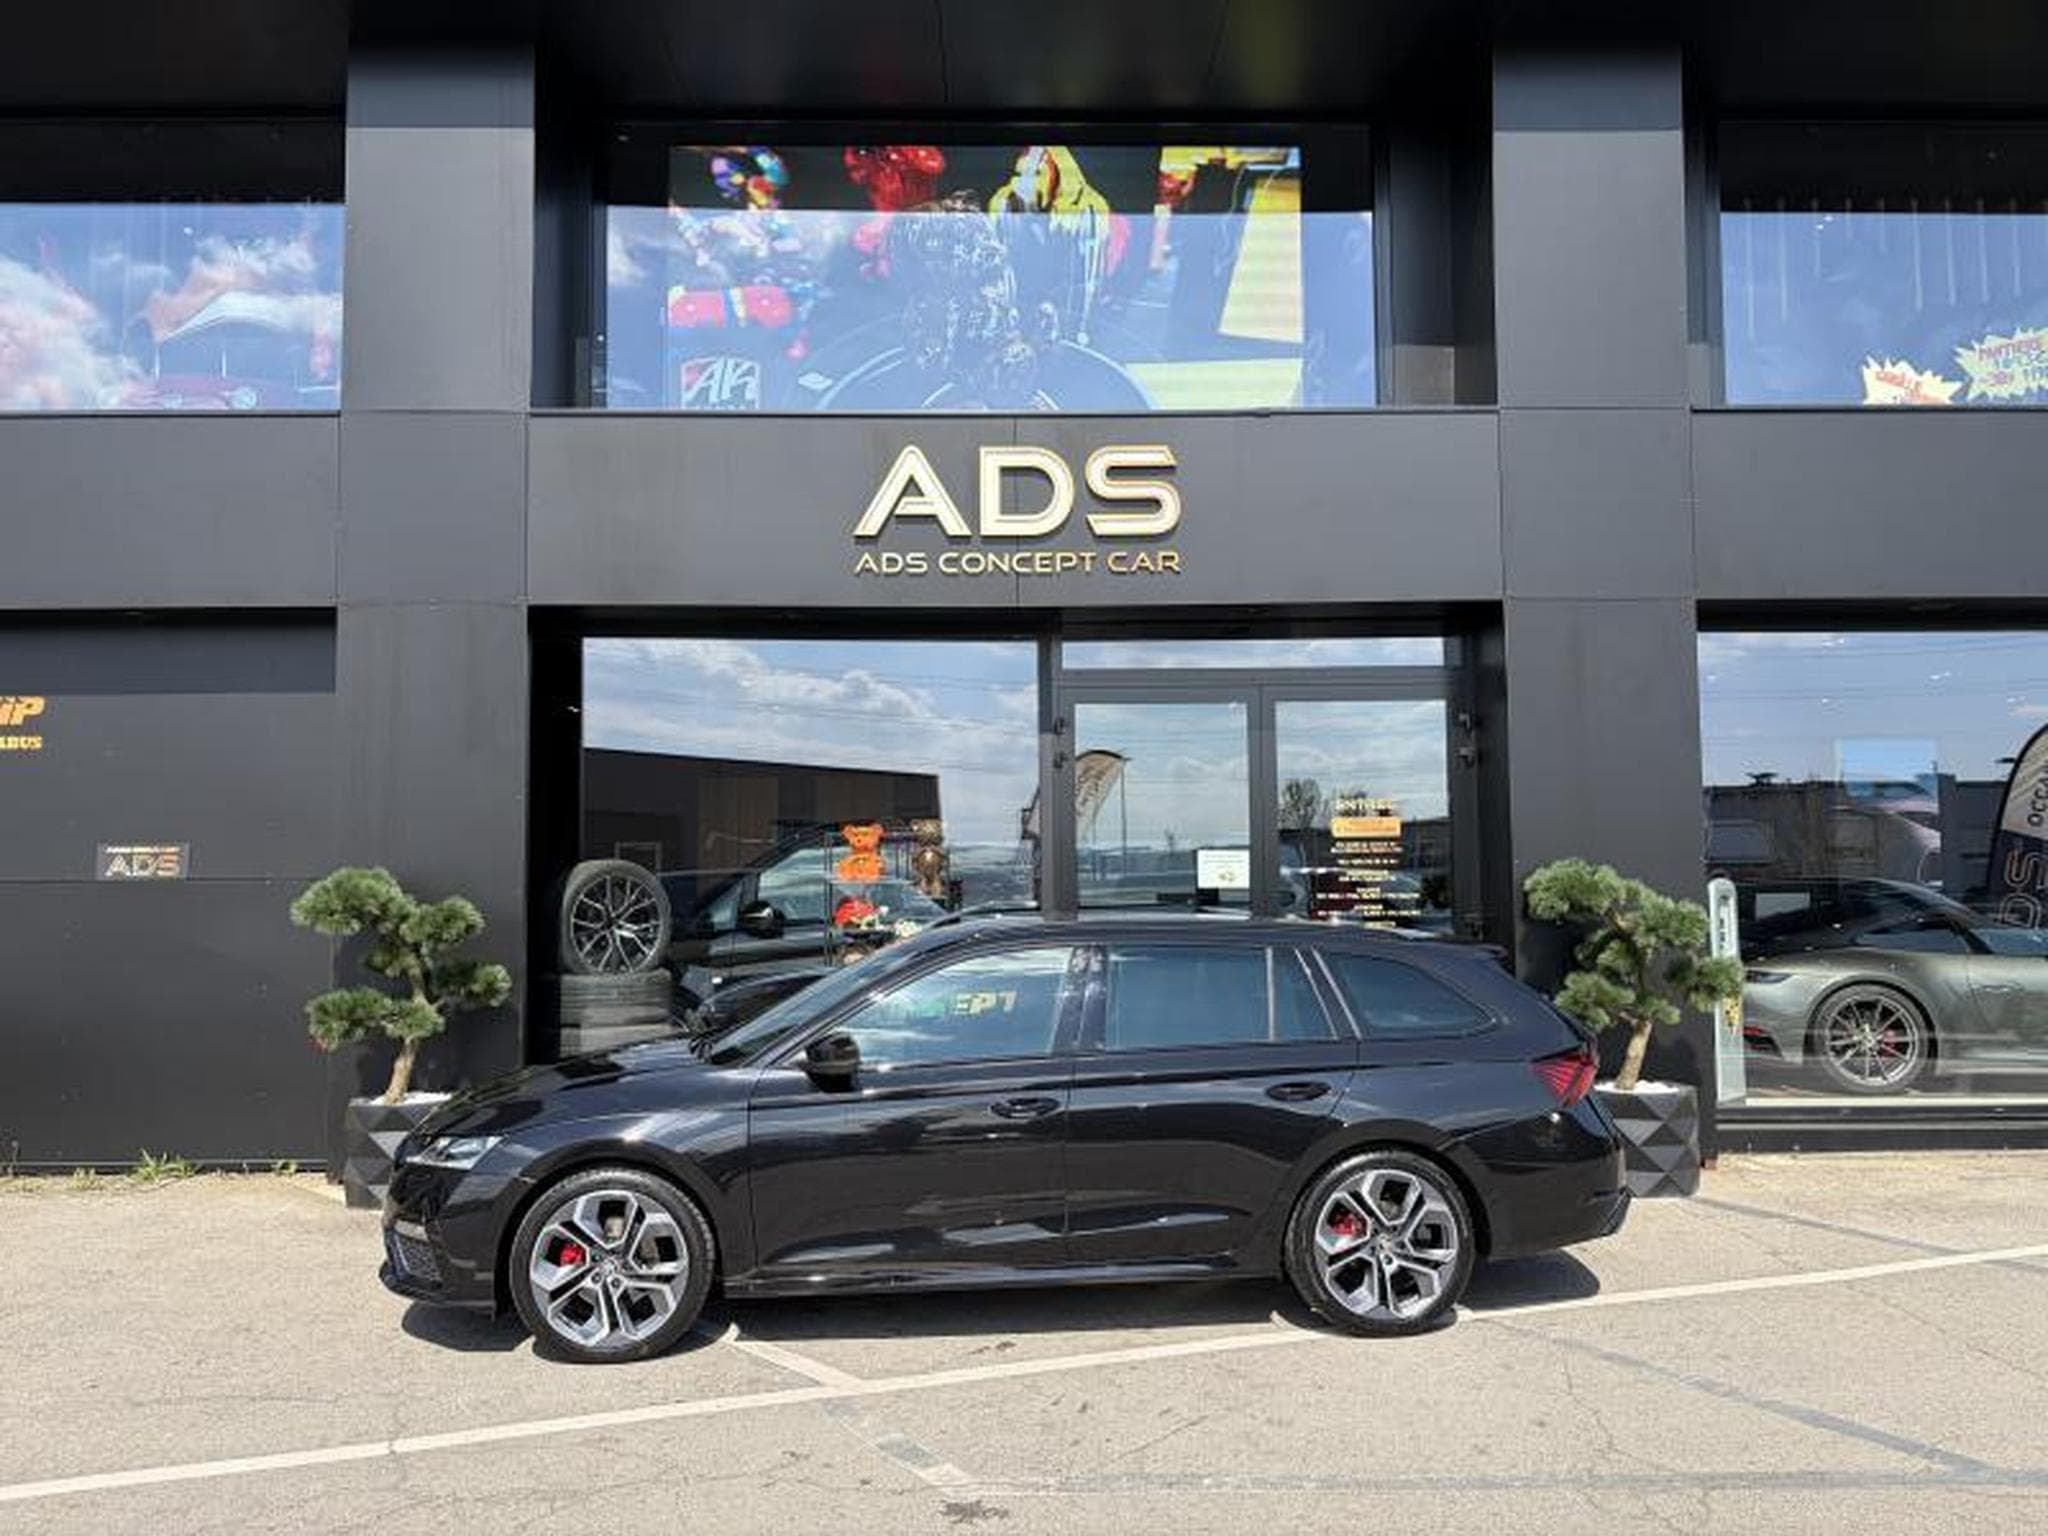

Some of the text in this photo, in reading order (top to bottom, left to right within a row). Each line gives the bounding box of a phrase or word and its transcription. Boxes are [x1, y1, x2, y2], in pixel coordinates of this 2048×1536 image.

[853, 444, 1181, 537] ADS
[854, 552, 1182, 574] ADS CONCEPT CAR
[104, 855, 180, 876] ADS
